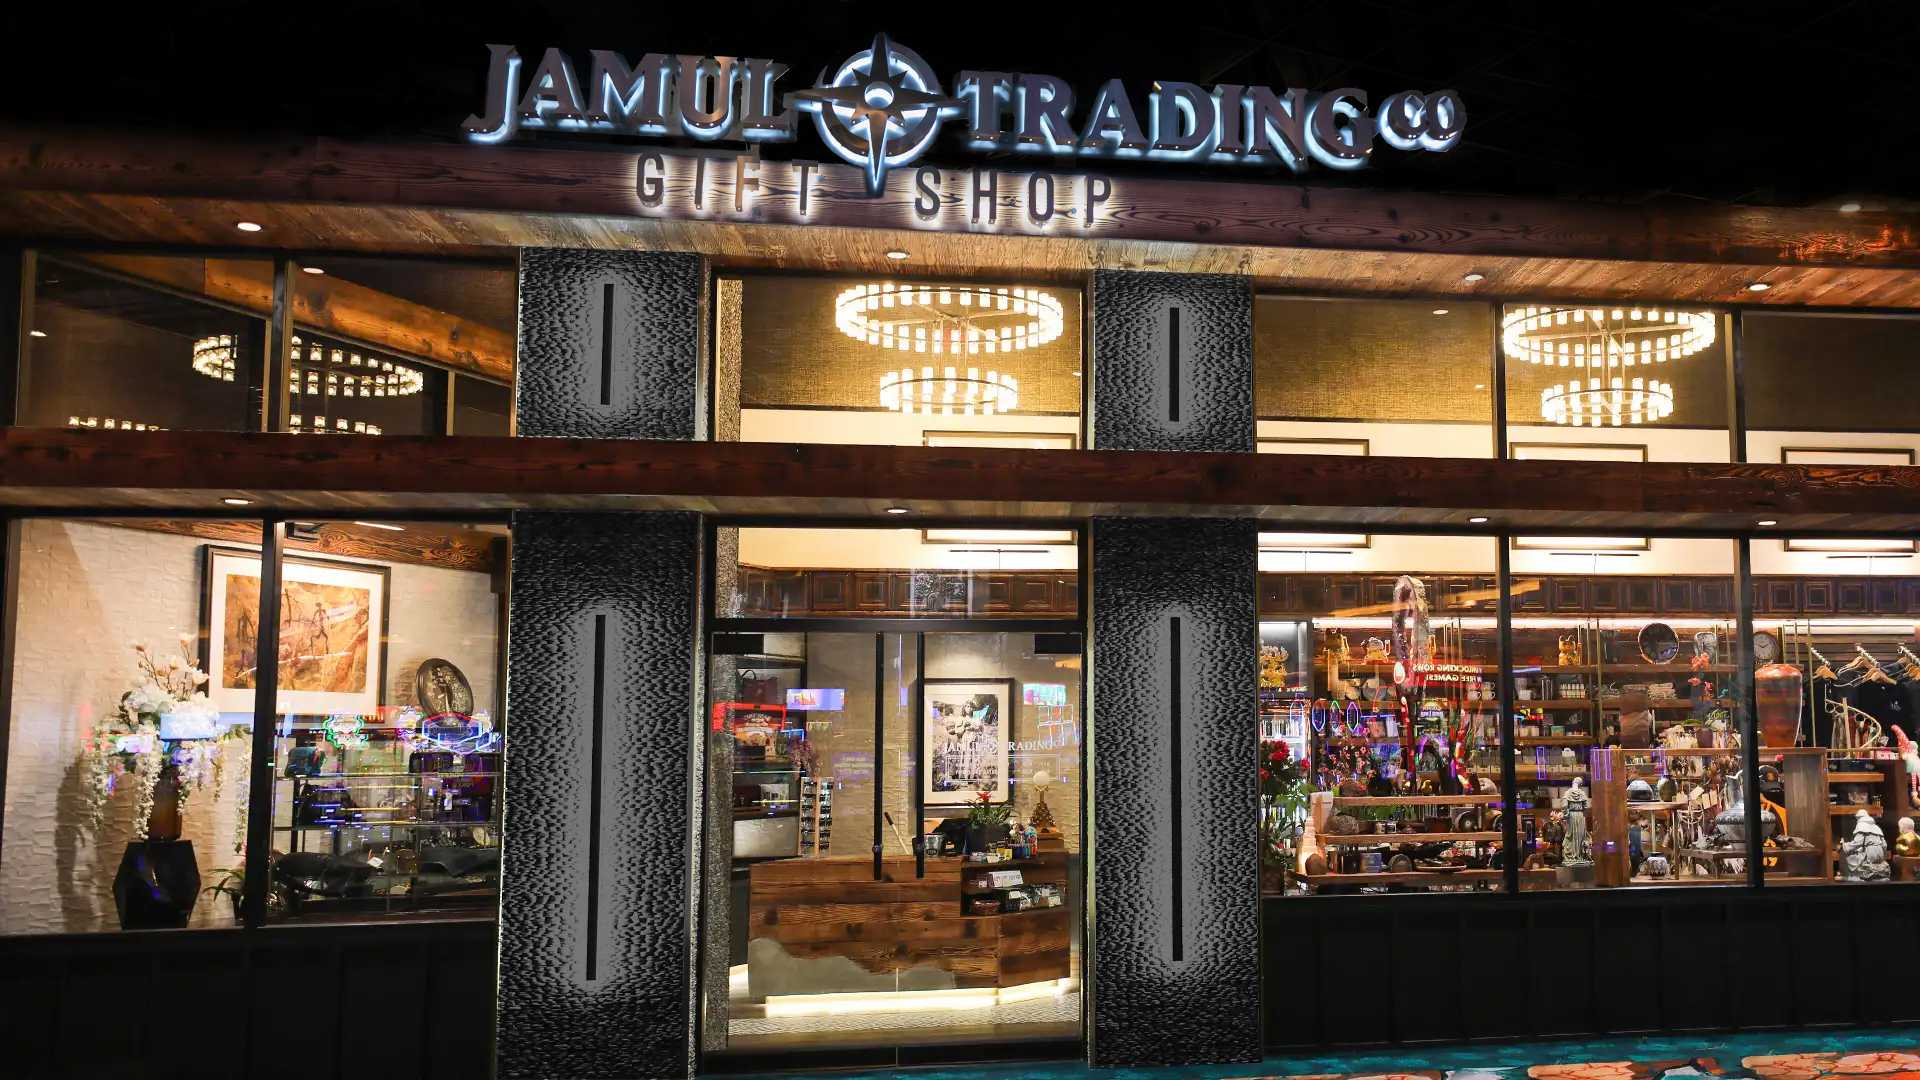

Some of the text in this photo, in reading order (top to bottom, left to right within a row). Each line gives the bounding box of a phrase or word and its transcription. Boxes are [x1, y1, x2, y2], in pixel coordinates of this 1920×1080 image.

[463, 44, 1467, 168] JAMUL TRADING CO
[636, 152, 1111, 227] GIFT SHOP
